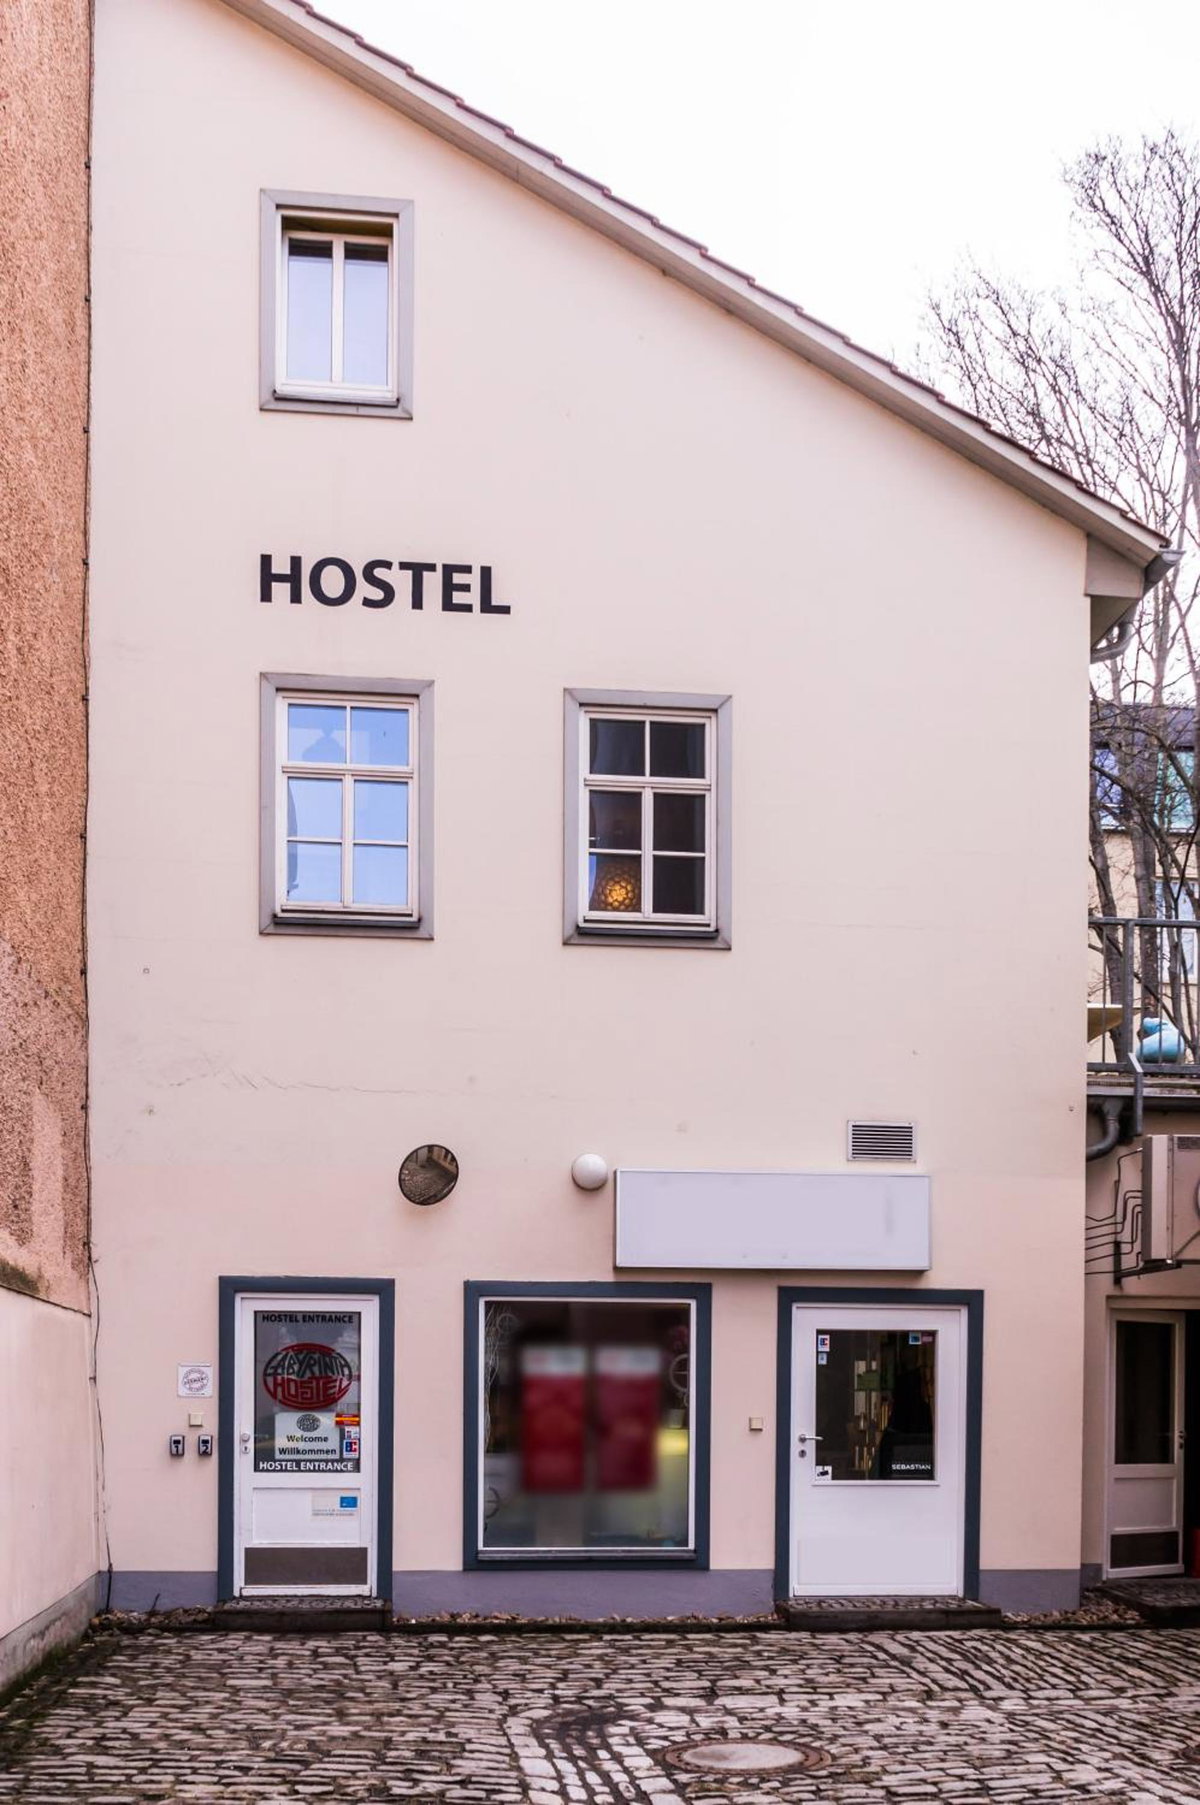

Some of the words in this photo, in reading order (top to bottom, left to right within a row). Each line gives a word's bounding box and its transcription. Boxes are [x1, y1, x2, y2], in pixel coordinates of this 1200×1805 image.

[260, 554, 511, 615] HOSTEL
[262, 1313, 300, 1323] HOSTEL
[302, 1314, 354, 1324] ENTRANCE
[272, 1375, 351, 1403] HOSTEL
[286, 1434, 329, 1443] Welcome
[278, 1446, 337, 1456] Willkommen
[259, 1461, 299, 1471] HOSTEL
[301, 1461, 354, 1471] ENTRANCE
[891, 1463, 931, 1471] SEBASTIAN
